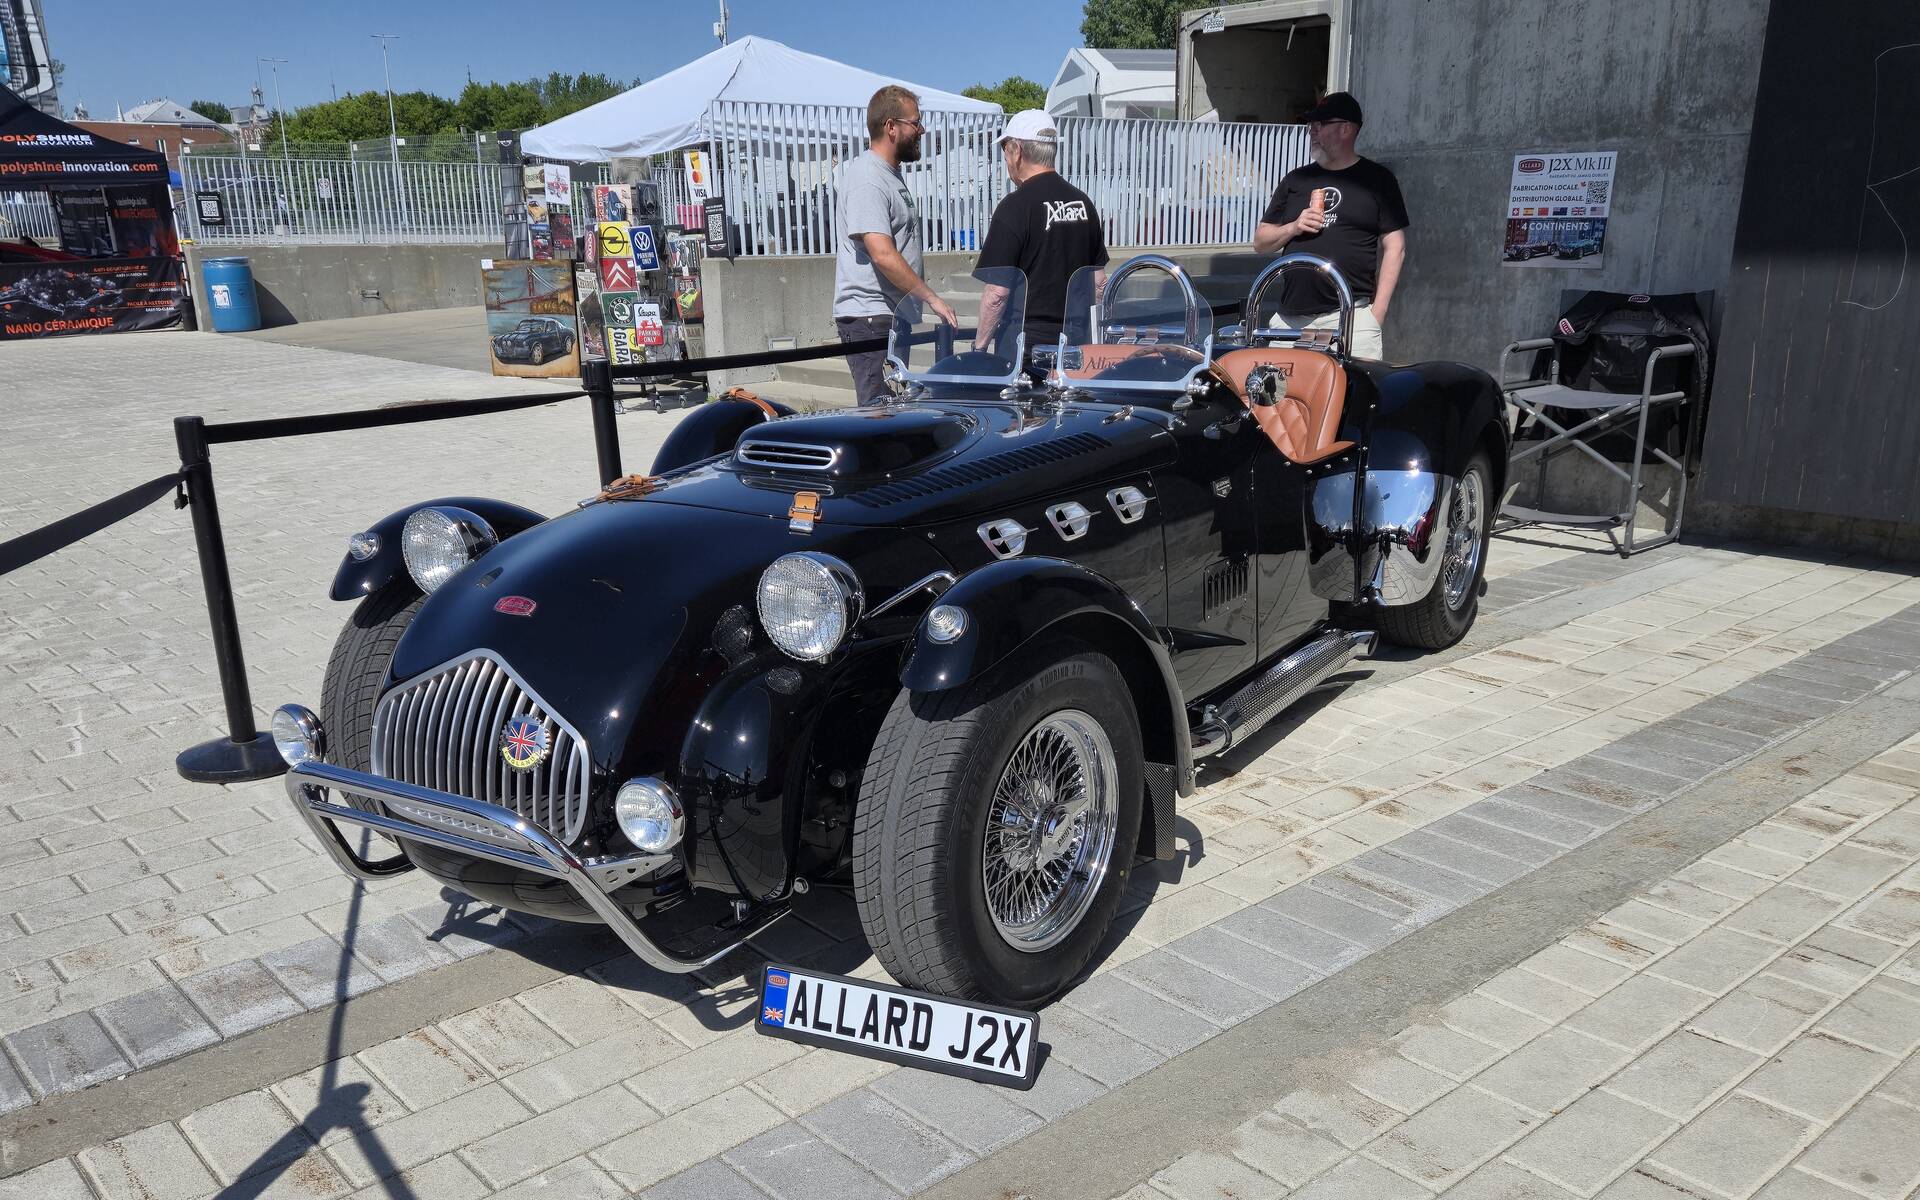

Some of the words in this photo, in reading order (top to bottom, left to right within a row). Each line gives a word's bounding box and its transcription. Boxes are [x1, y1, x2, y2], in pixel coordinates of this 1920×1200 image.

[1, 162, 158, 174] polyshineinnovation.com
[1548, 159, 1573, 174] J2X
[694, 188, 707, 198] VISA
[1529, 222, 1589, 231] CONTINENTS
[638, 306, 656, 317] Vespa
[6, 322, 42, 334] NANO
[44, 317, 114, 331] CÉRAMIQUE
[614, 332, 630, 364] GARA
[789, 980, 933, 1052] ALLARD
[948, 1012, 1026, 1072] J2X
